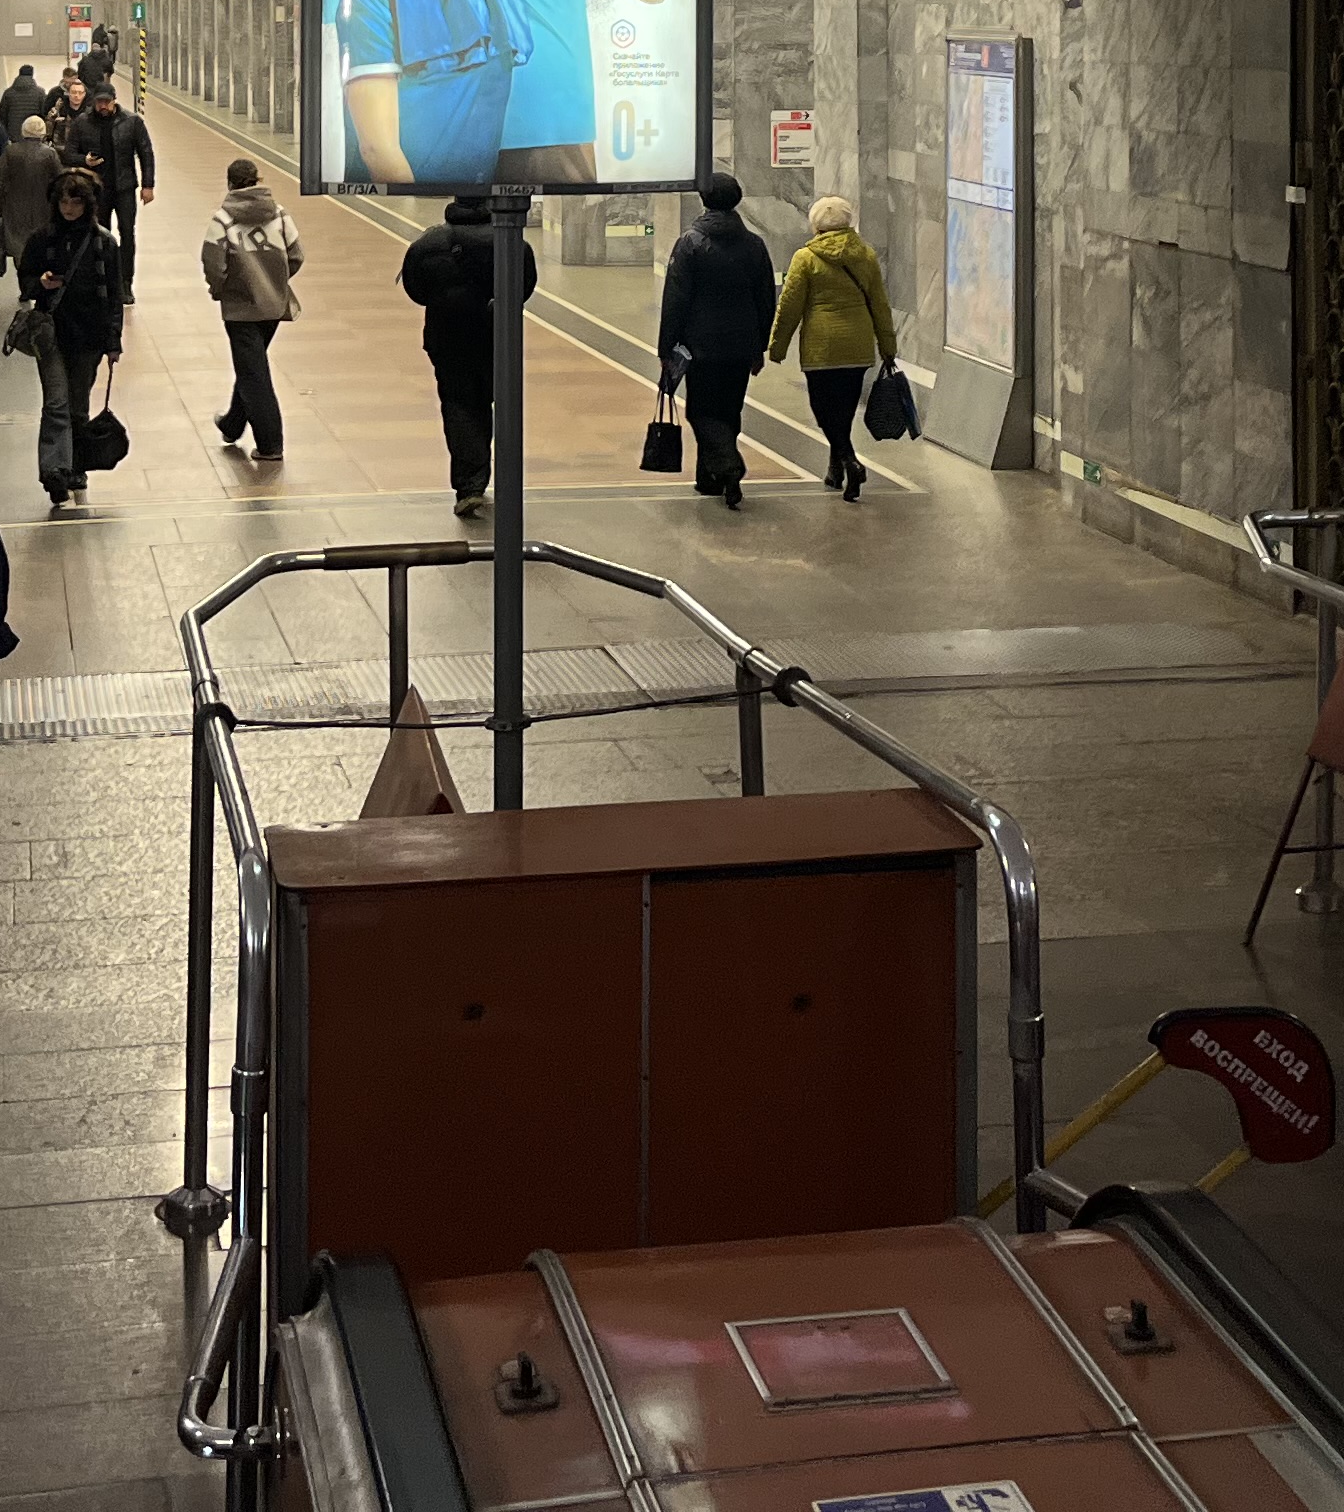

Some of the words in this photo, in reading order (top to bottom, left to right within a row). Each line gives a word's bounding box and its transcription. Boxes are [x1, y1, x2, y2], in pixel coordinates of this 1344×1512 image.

[613, 100, 659, 161] 0+
[1189, 1029, 1320, 1134] ВОСПРЕЩЕН!
[1253, 1029, 1309, 1083] ВХОД
